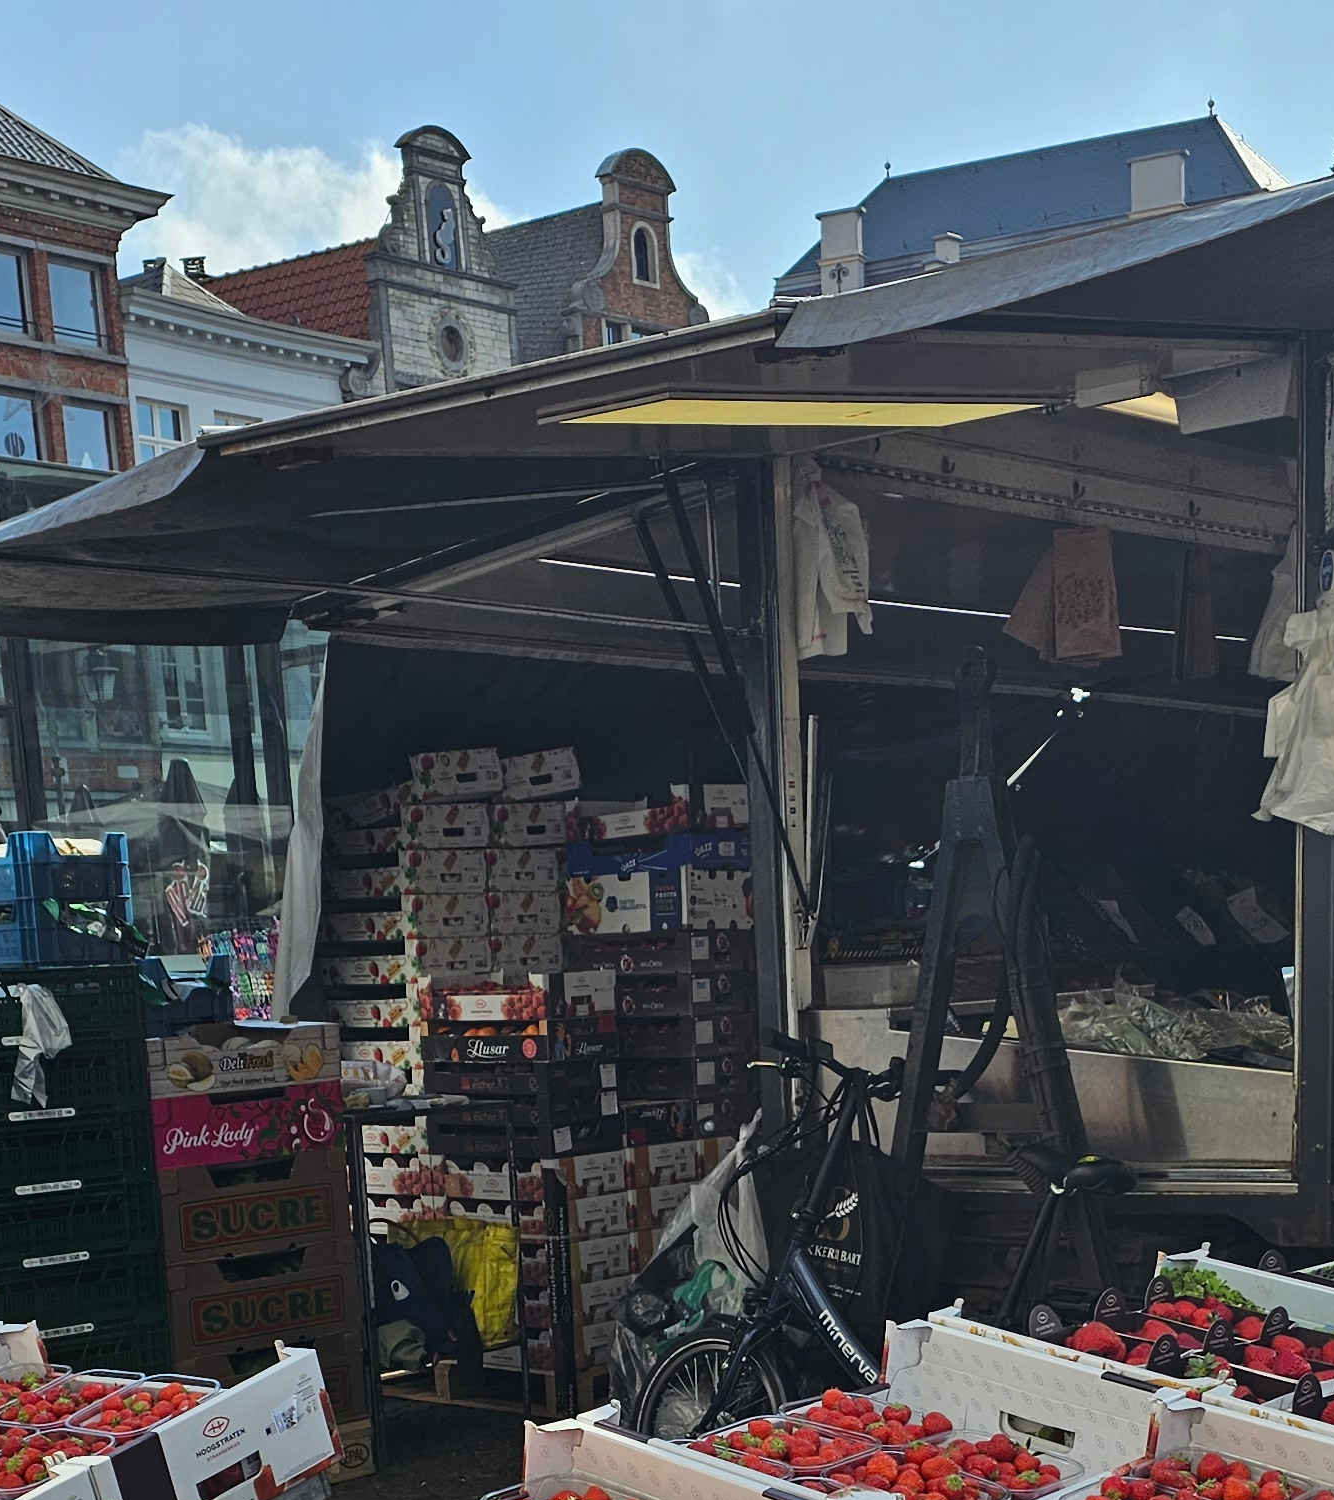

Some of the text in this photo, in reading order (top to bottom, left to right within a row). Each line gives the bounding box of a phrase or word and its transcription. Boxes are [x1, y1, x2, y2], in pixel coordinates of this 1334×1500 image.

[163, 1122, 255, 1155] Pink Lady
[191, 1195, 324, 1241] SUCRE
[840, 1249, 862, 1266] BART
[201, 1287, 335, 1334] SUCRE
[818, 1307, 880, 1385] minerva
